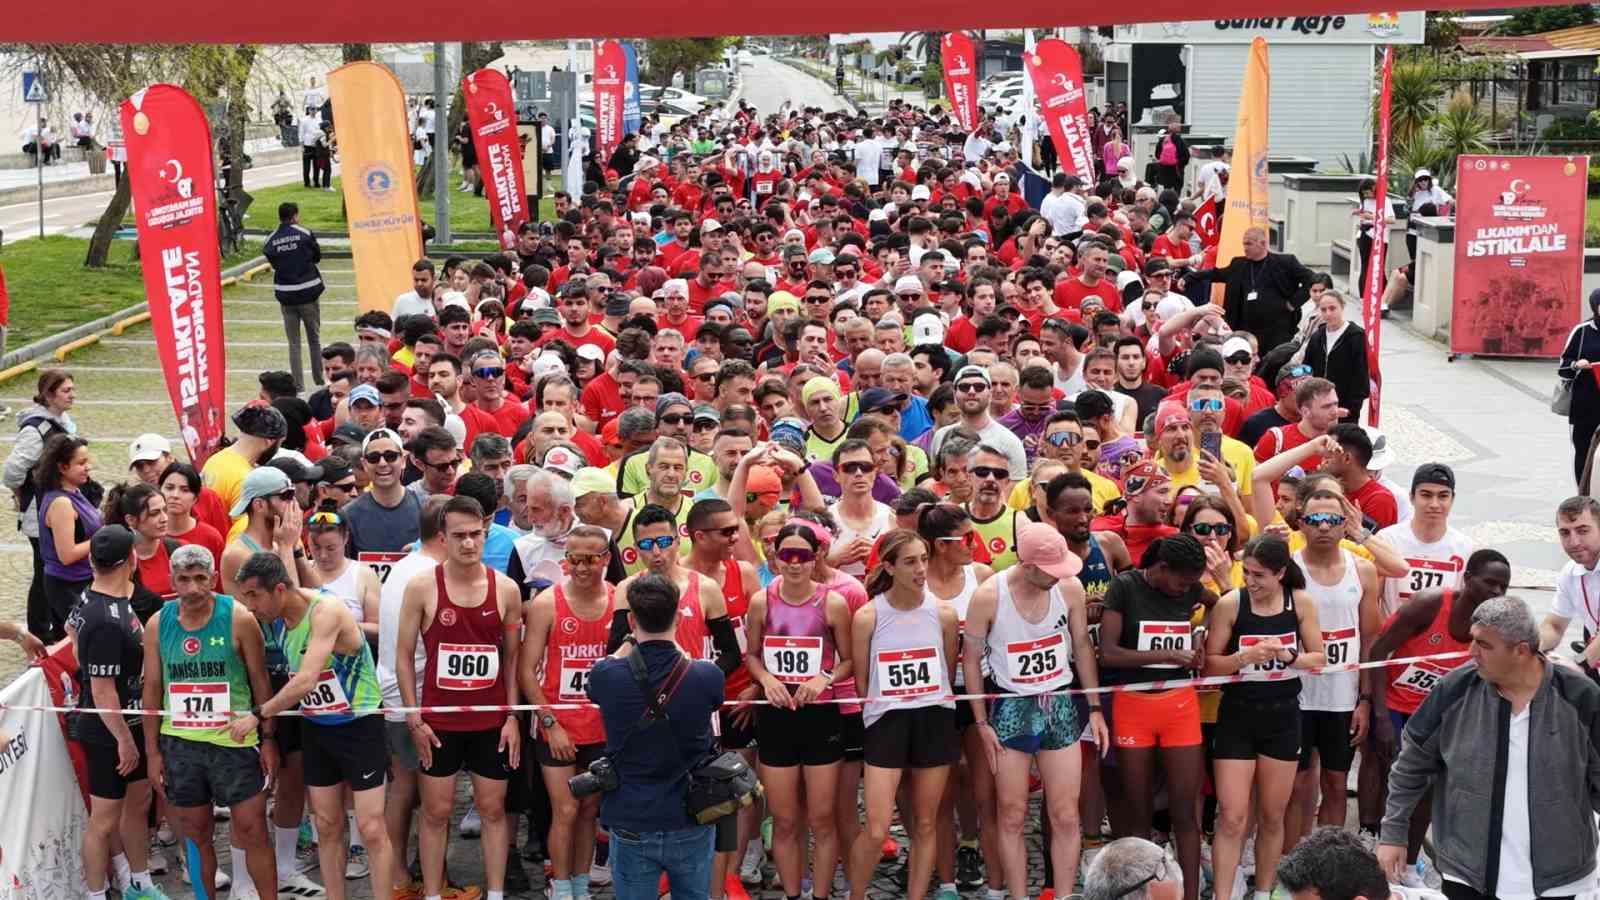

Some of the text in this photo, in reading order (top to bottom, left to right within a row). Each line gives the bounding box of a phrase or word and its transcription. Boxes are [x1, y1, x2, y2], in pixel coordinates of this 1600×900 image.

[1410, 570, 1443, 591] 377
[559, 642, 608, 659] TÜRKİ
[774, 650, 809, 674] 198
[1322, 641, 1348, 664] 97
[448, 654, 489, 677] 960
[1018, 649, 1057, 676] 235
[888, 662, 931, 687] 554
[1407, 670, 1440, 689] 35
[183, 696, 214, 719] 174
